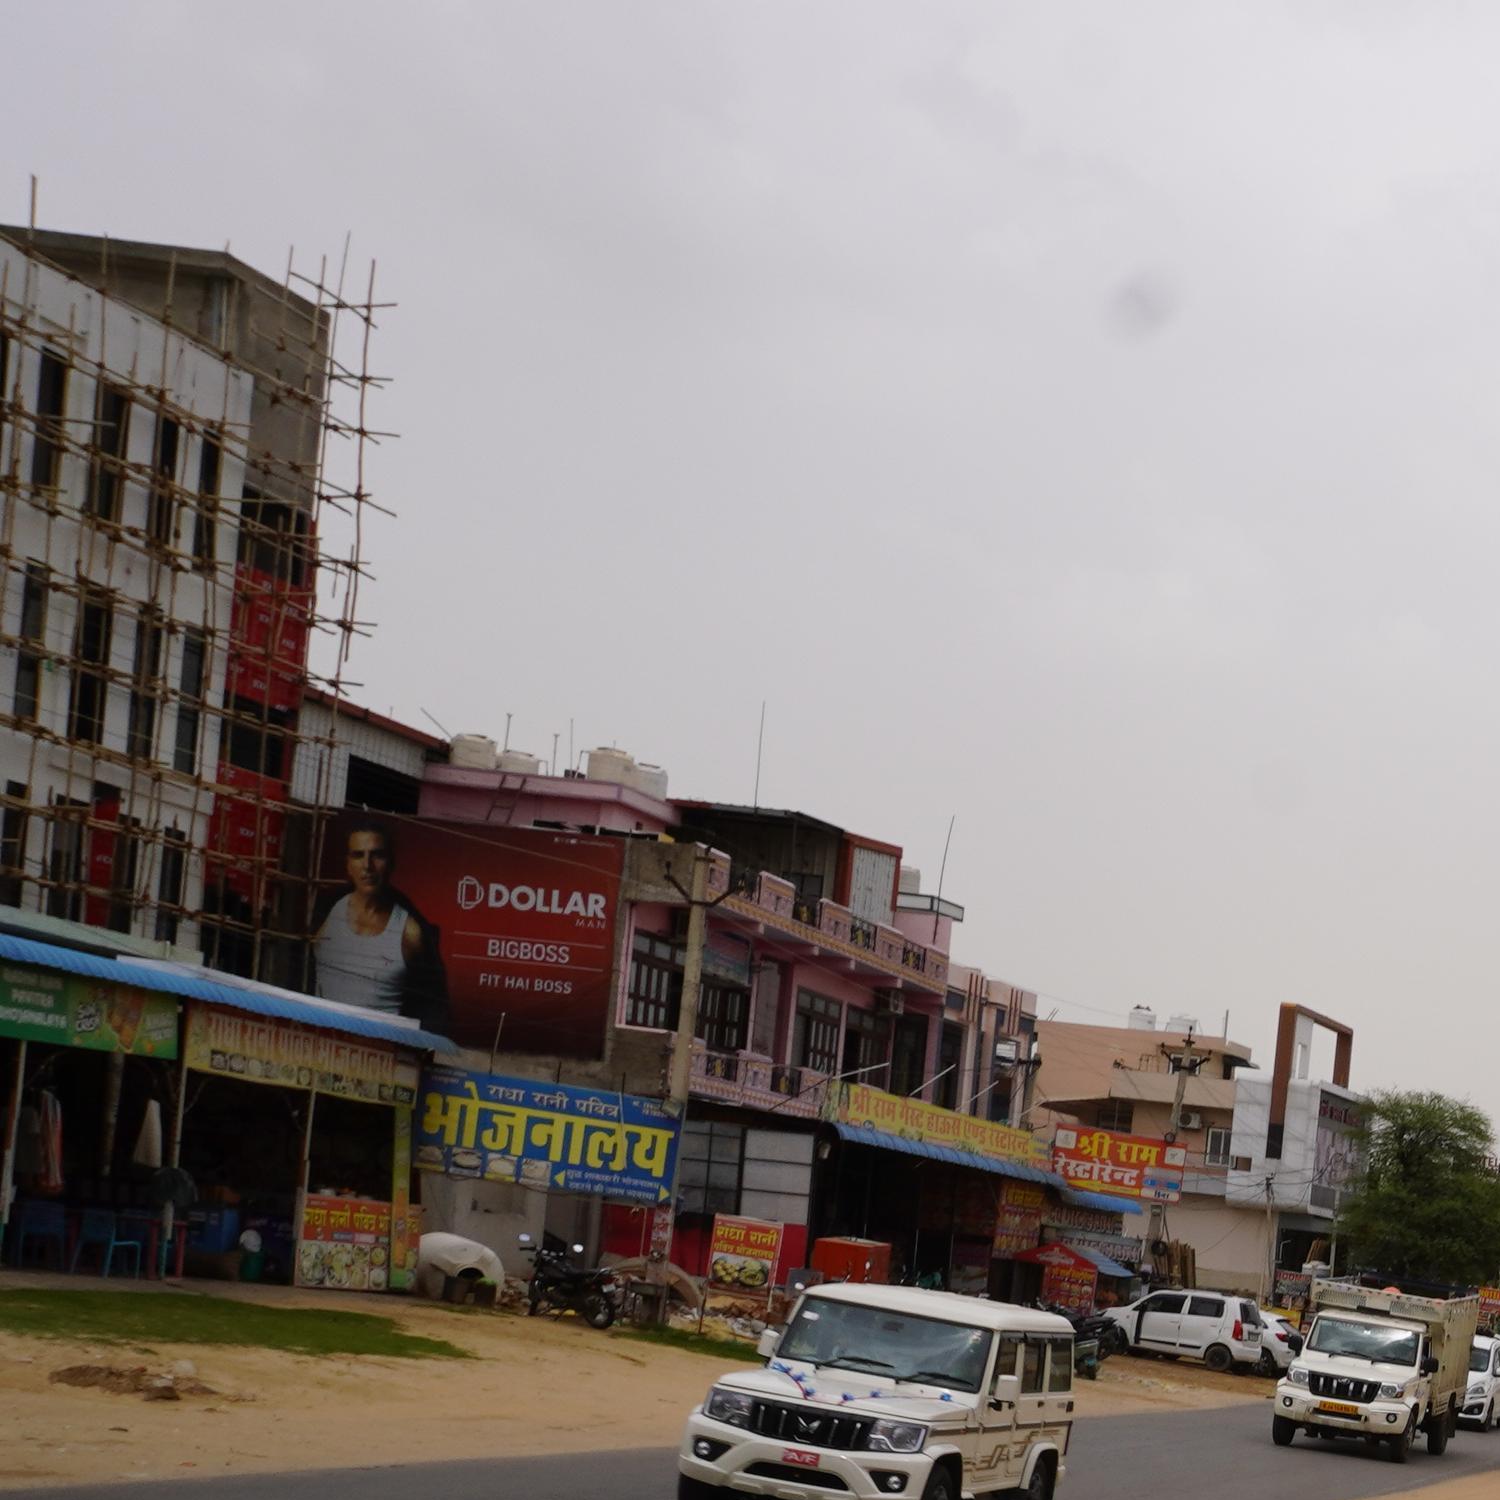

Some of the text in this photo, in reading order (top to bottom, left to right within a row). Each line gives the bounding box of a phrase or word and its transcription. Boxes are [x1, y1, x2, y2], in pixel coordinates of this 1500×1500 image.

[487, 882, 606, 919] DOLLAR
[574, 918, 606, 929] MAN
[487, 938, 570, 964] BIGBOSS
[479, 972, 573, 994] FIT HAI BOSS
[488, 1083, 526, 1104] राधा
[532, 1090, 569, 1110] रानी
[575, 1096, 620, 1118] पवित्र
[422, 1080, 675, 1178] भोजनालय
[1079, 1132, 1161, 1166] श्री राम
